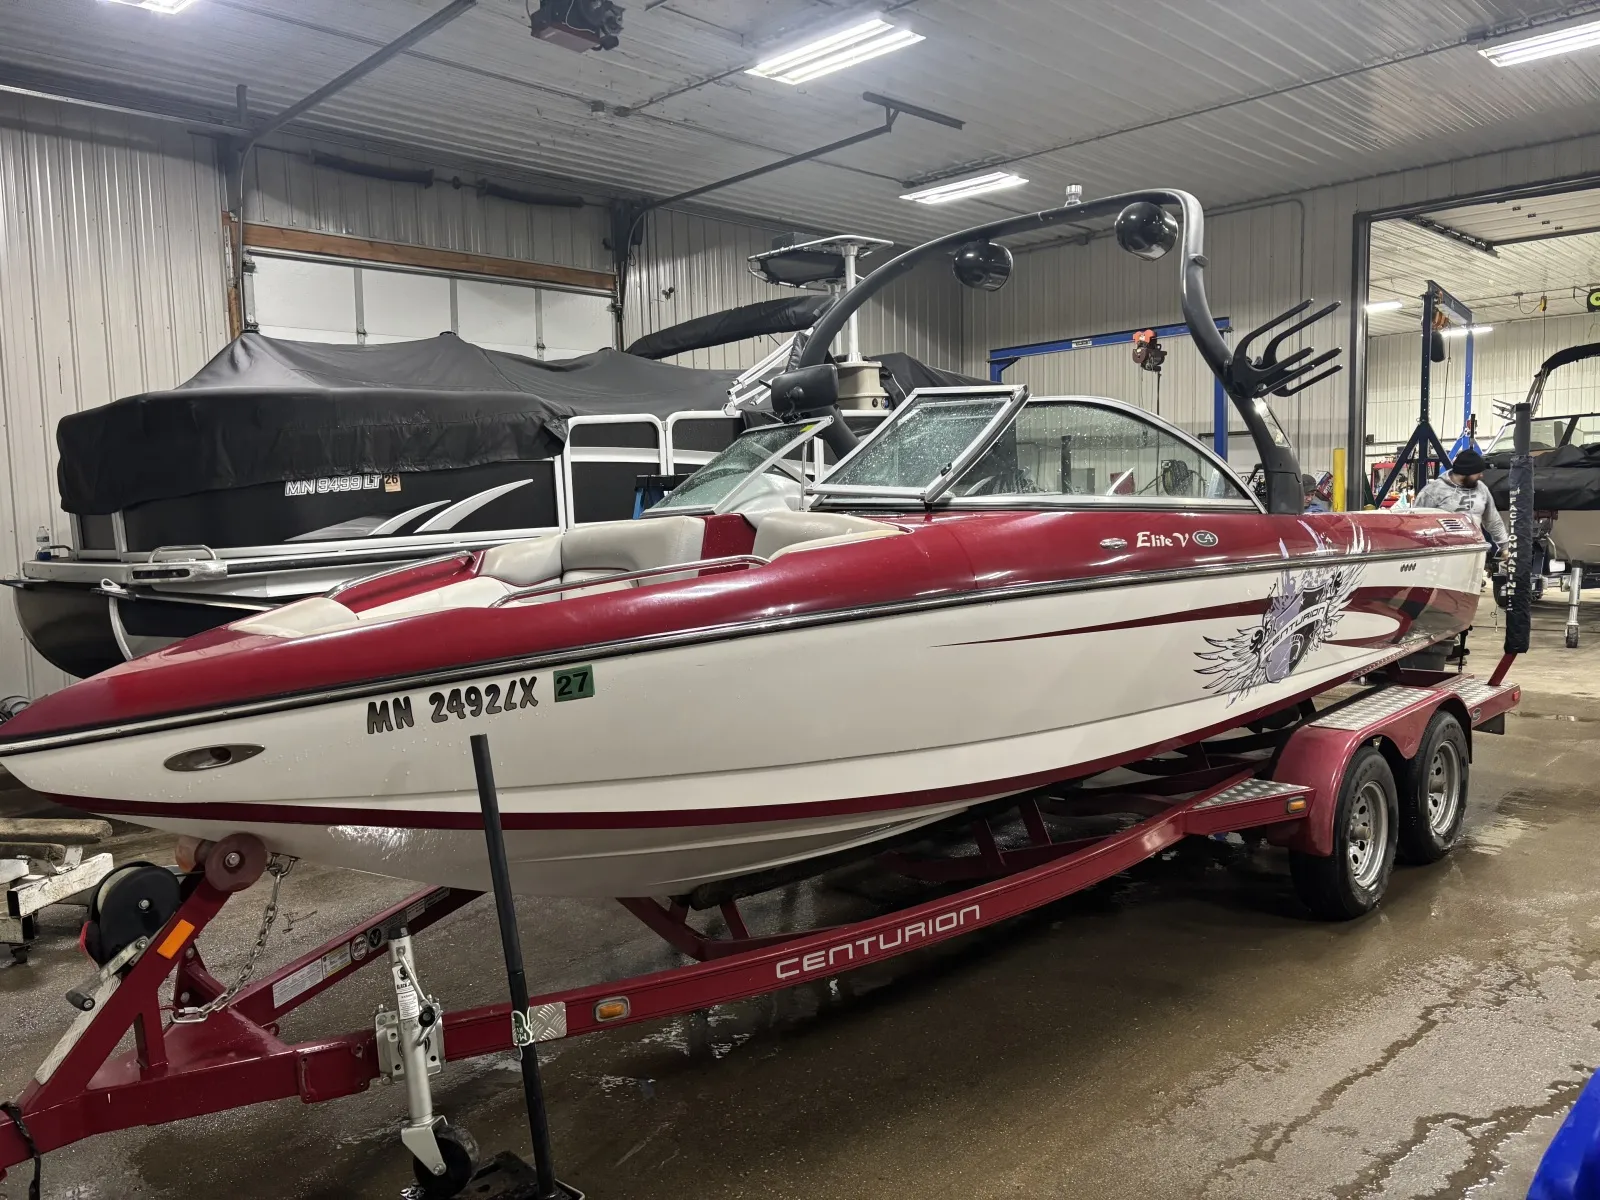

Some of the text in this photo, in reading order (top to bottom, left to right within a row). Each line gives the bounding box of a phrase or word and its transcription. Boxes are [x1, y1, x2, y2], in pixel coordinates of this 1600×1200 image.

[285, 480, 315, 496] MN
[363, 474, 382, 489] LT
[385, 474, 399, 485] 26
[1136, 531, 1173, 548] Elite
[1172, 532, 1189, 548] V
[1264, 606, 1325, 655] CENTURION
[556, 672, 589, 697] 27
[367, 696, 414, 734] MN
[776, 904, 980, 979] CENTURION
